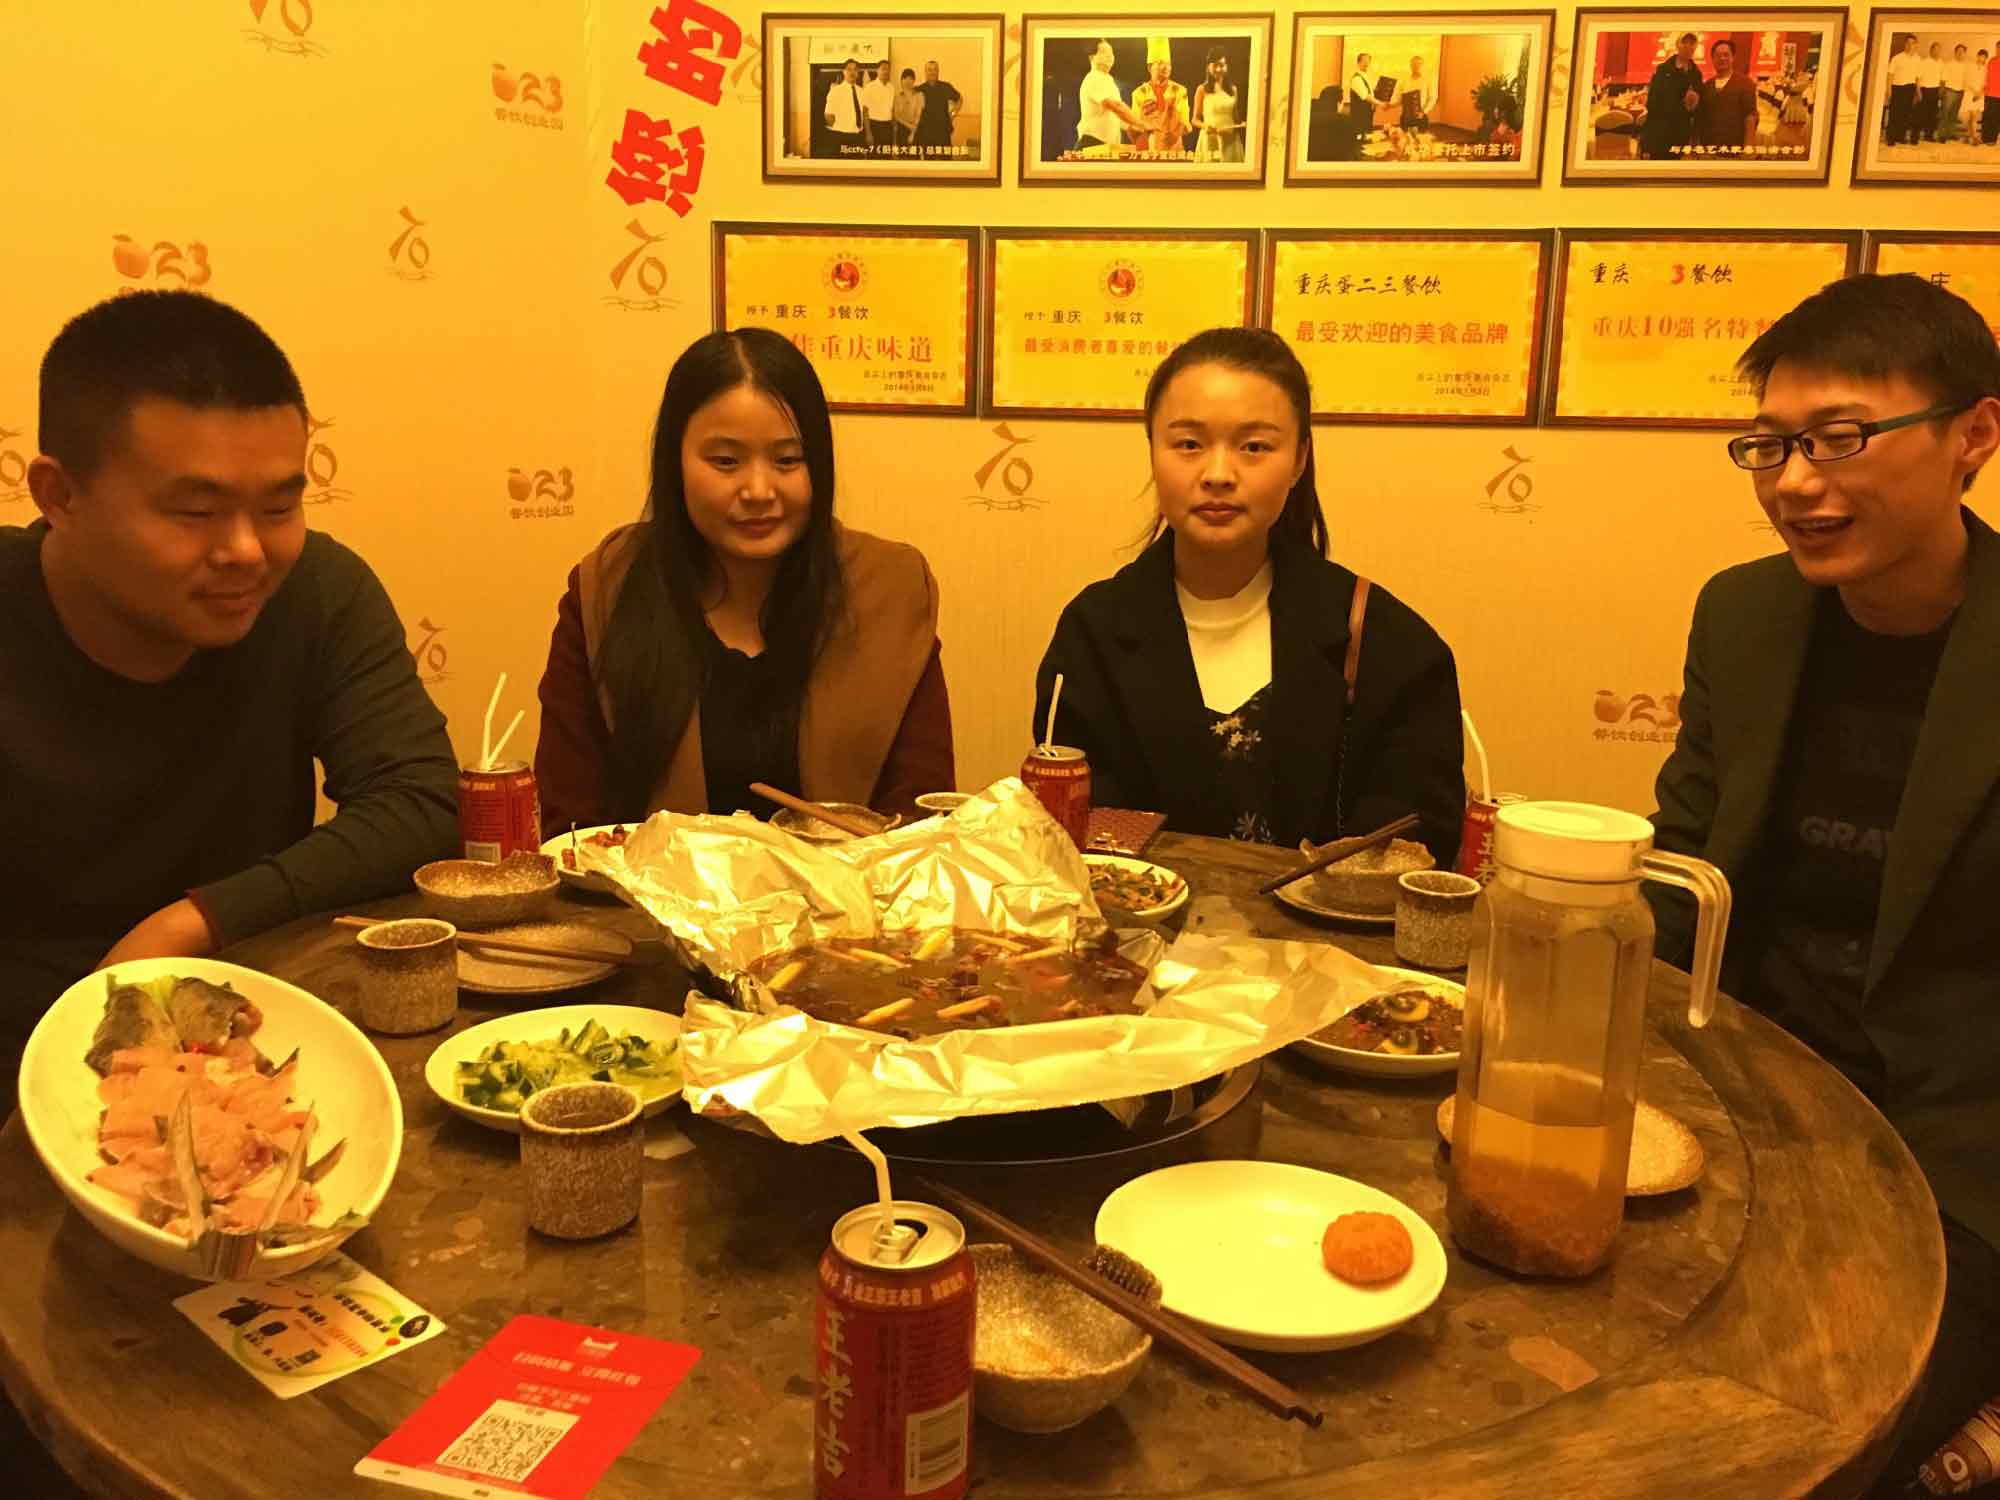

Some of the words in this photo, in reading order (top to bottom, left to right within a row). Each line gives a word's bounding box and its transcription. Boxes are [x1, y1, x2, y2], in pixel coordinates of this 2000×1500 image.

[1590, 261, 1630, 285] 重庆
[1295, 272, 1441, 297] 重庆蛋二三餐饮
[775, 303, 808, 320] 重庆
[1052, 309, 1082, 325] 重庆
[1295, 320, 1509, 345] 最受欢迎的美食品牌
[1024, 337, 1178, 356] 最受消费者喜爱的餐
